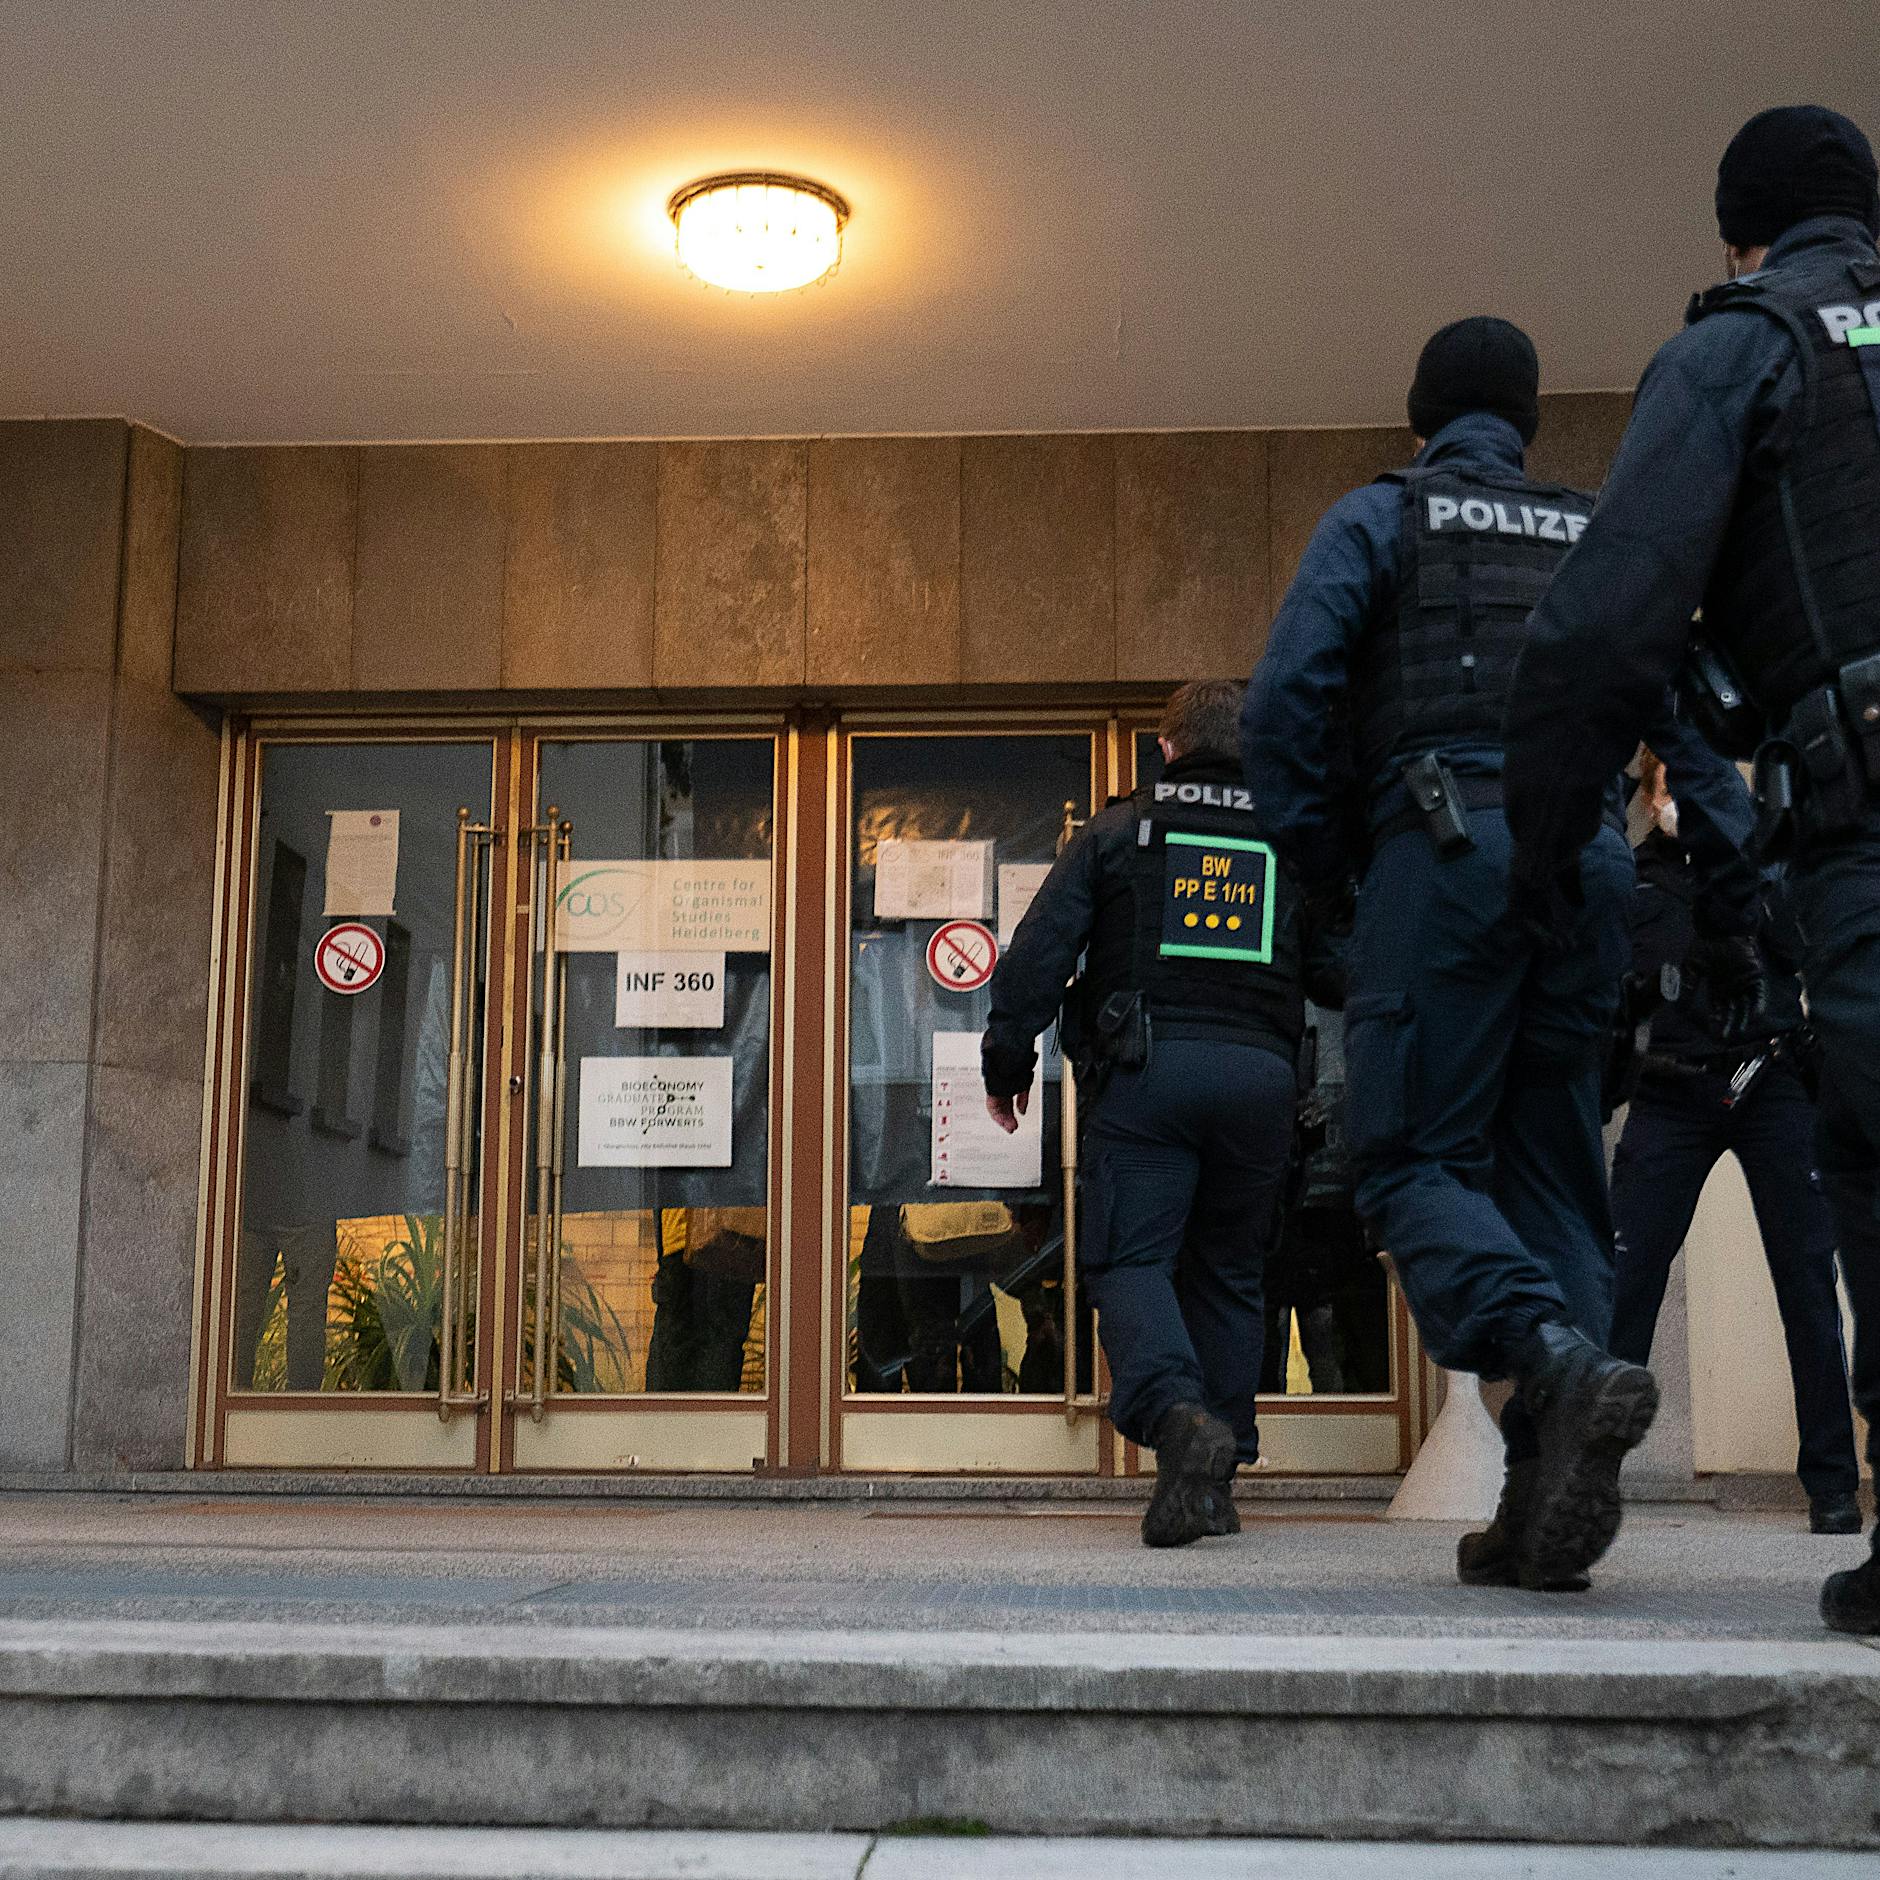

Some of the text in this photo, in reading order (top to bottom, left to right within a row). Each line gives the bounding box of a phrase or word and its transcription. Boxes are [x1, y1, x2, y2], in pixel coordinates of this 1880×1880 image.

[1154, 783, 1254, 811] POLIZ
[1202, 855, 1232, 878] BW
[672, 878, 756, 892] Centre for
[1173, 878, 1256, 905] PP E 1/11
[672, 895, 763, 910] Organismal
[672, 911, 732, 924] Studies
[671, 926, 761, 941] Heidelberg
[626, 972, 715, 992] INF 360
[621, 1081, 704, 1092] BIOECONOMY
[597, 1093, 667, 1104] GRADUATE
[641, 1105, 704, 1116] PROGRAM
[609, 1117, 704, 1128] BBW FORWERTS
